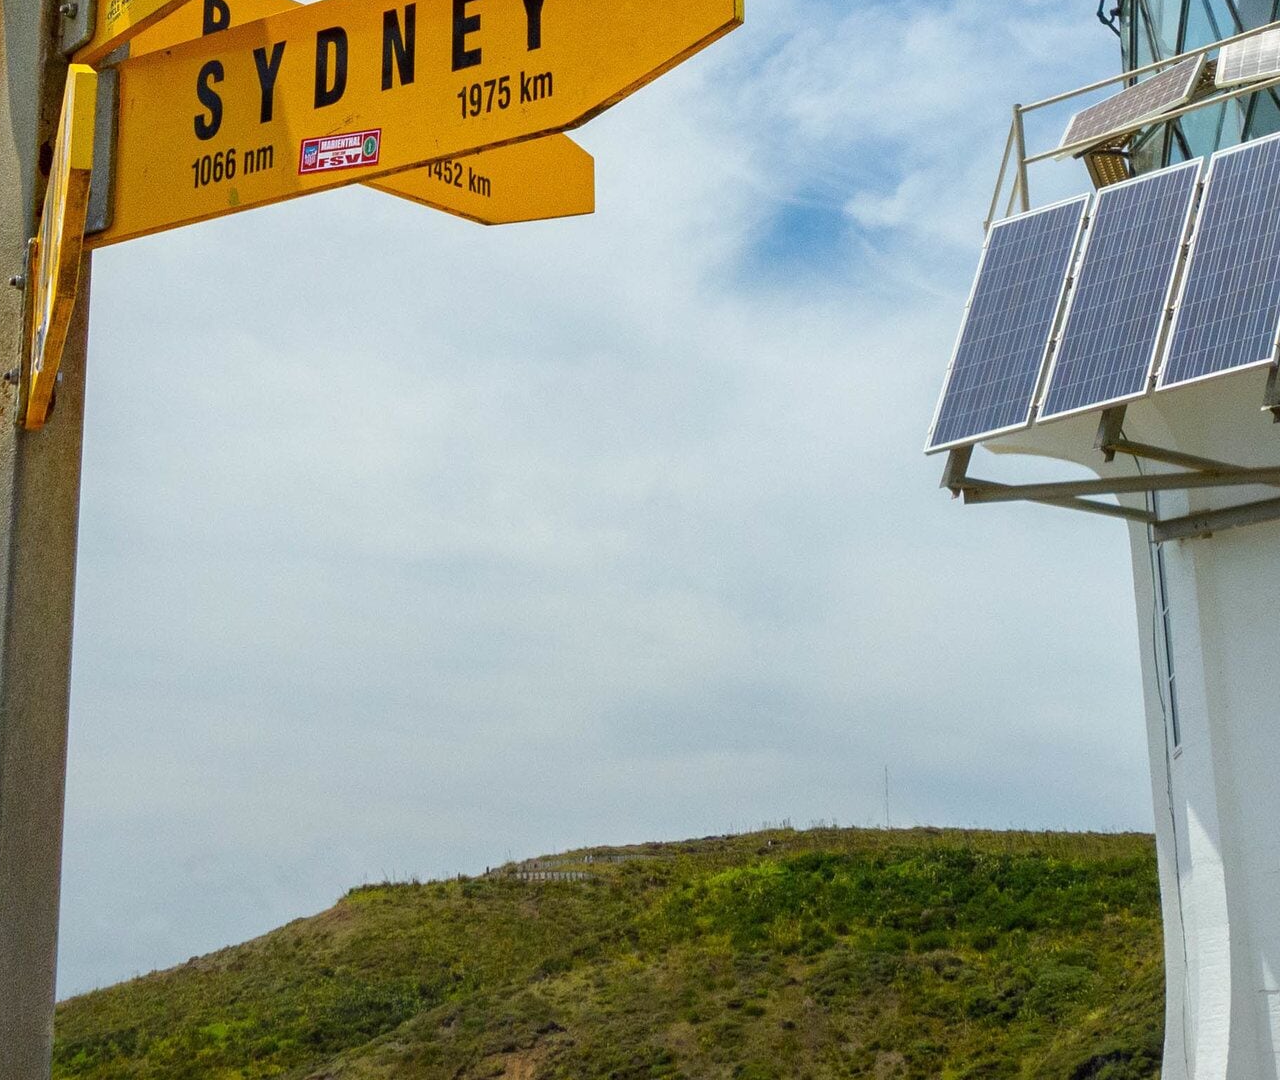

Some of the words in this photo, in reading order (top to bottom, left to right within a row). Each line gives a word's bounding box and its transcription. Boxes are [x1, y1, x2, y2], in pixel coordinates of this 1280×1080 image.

[457, 79, 512, 120] 1975
[519, 70, 554, 105] km
[190, 149, 237, 189] 1066
[242, 144, 275, 176] nm
[318, 153, 361, 168] FSV
[426, 160, 463, 188] 1452
[468, 167, 492, 198] km
